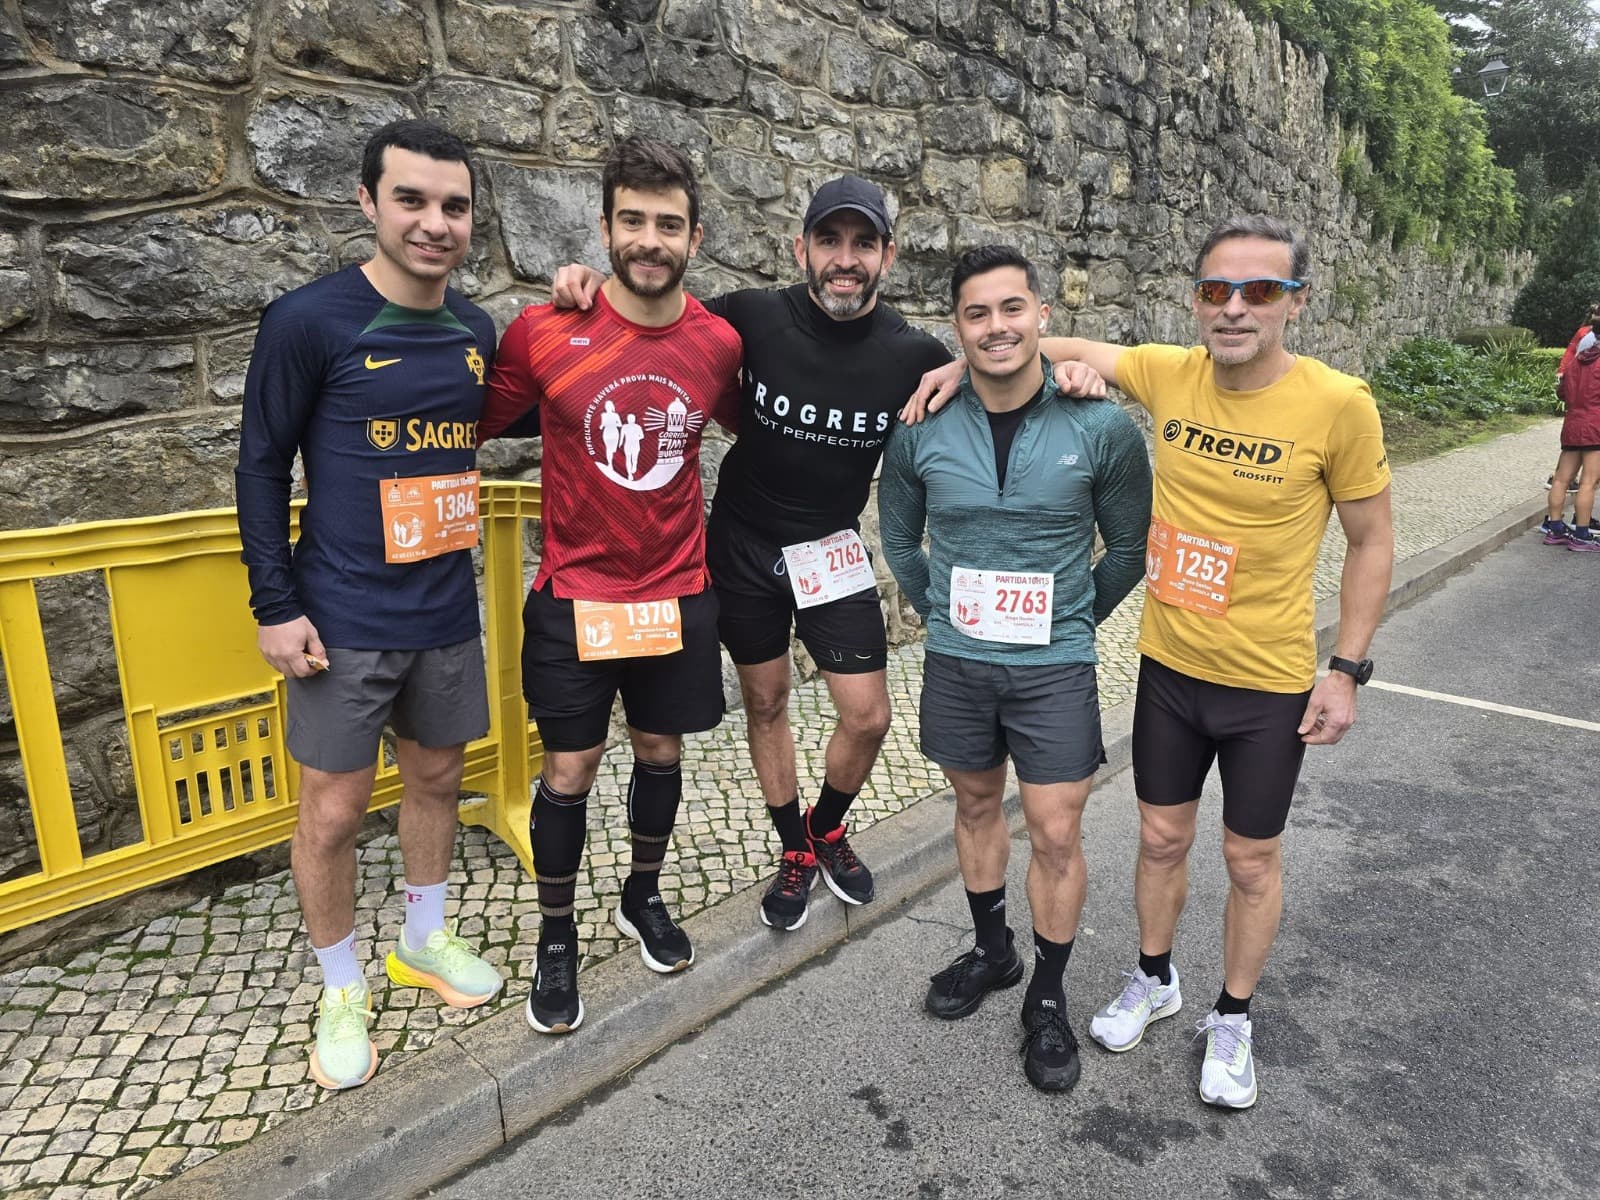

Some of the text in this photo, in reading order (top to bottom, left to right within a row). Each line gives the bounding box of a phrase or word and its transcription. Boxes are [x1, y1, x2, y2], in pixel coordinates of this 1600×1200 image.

[583, 404, 597, 456] DIFICILMENTE
[593, 379, 621, 404] HAVERÁ
[620, 374, 647, 385] PROVA
[648, 374, 668, 385] MAIS
[748, 370, 889, 432] ROGRES
[754, 408, 884, 448] NOT PERFECTION
[431, 479, 460, 490] PARTIDA
[434, 490, 476, 523] 1384
[1176, 532, 1210, 549] PARTIDA
[826, 542, 864, 572] 2762
[1176, 547, 1229, 586] 1252
[995, 575, 1051, 585] PARTIDA 10H15
[624, 601, 676, 626] 1370
[995, 589, 1047, 615] 2763
